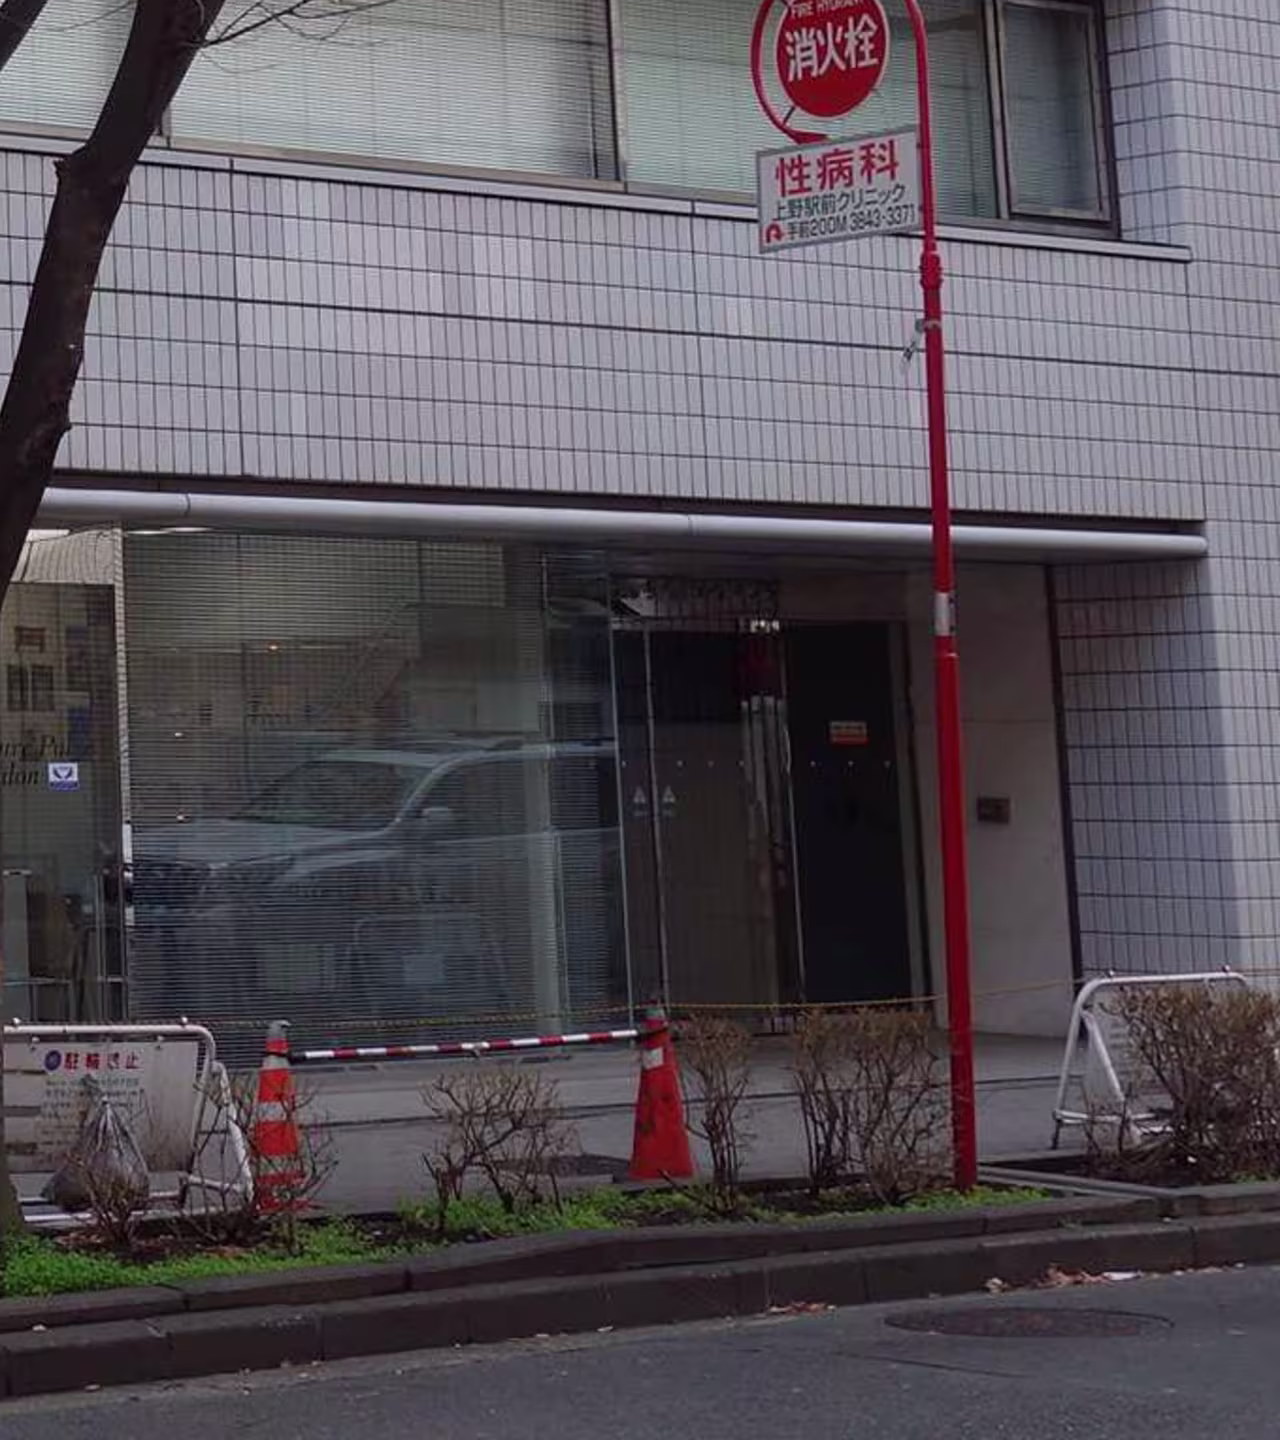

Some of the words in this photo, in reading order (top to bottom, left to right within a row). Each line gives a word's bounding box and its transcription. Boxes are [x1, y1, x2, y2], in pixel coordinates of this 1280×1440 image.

[790, 0, 814, 20] FIRE
[785, 13, 878, 82] 消火栓
[775, 140, 900, 197] 性病科
[772, 183, 907, 221] 上野駅前クリニック
